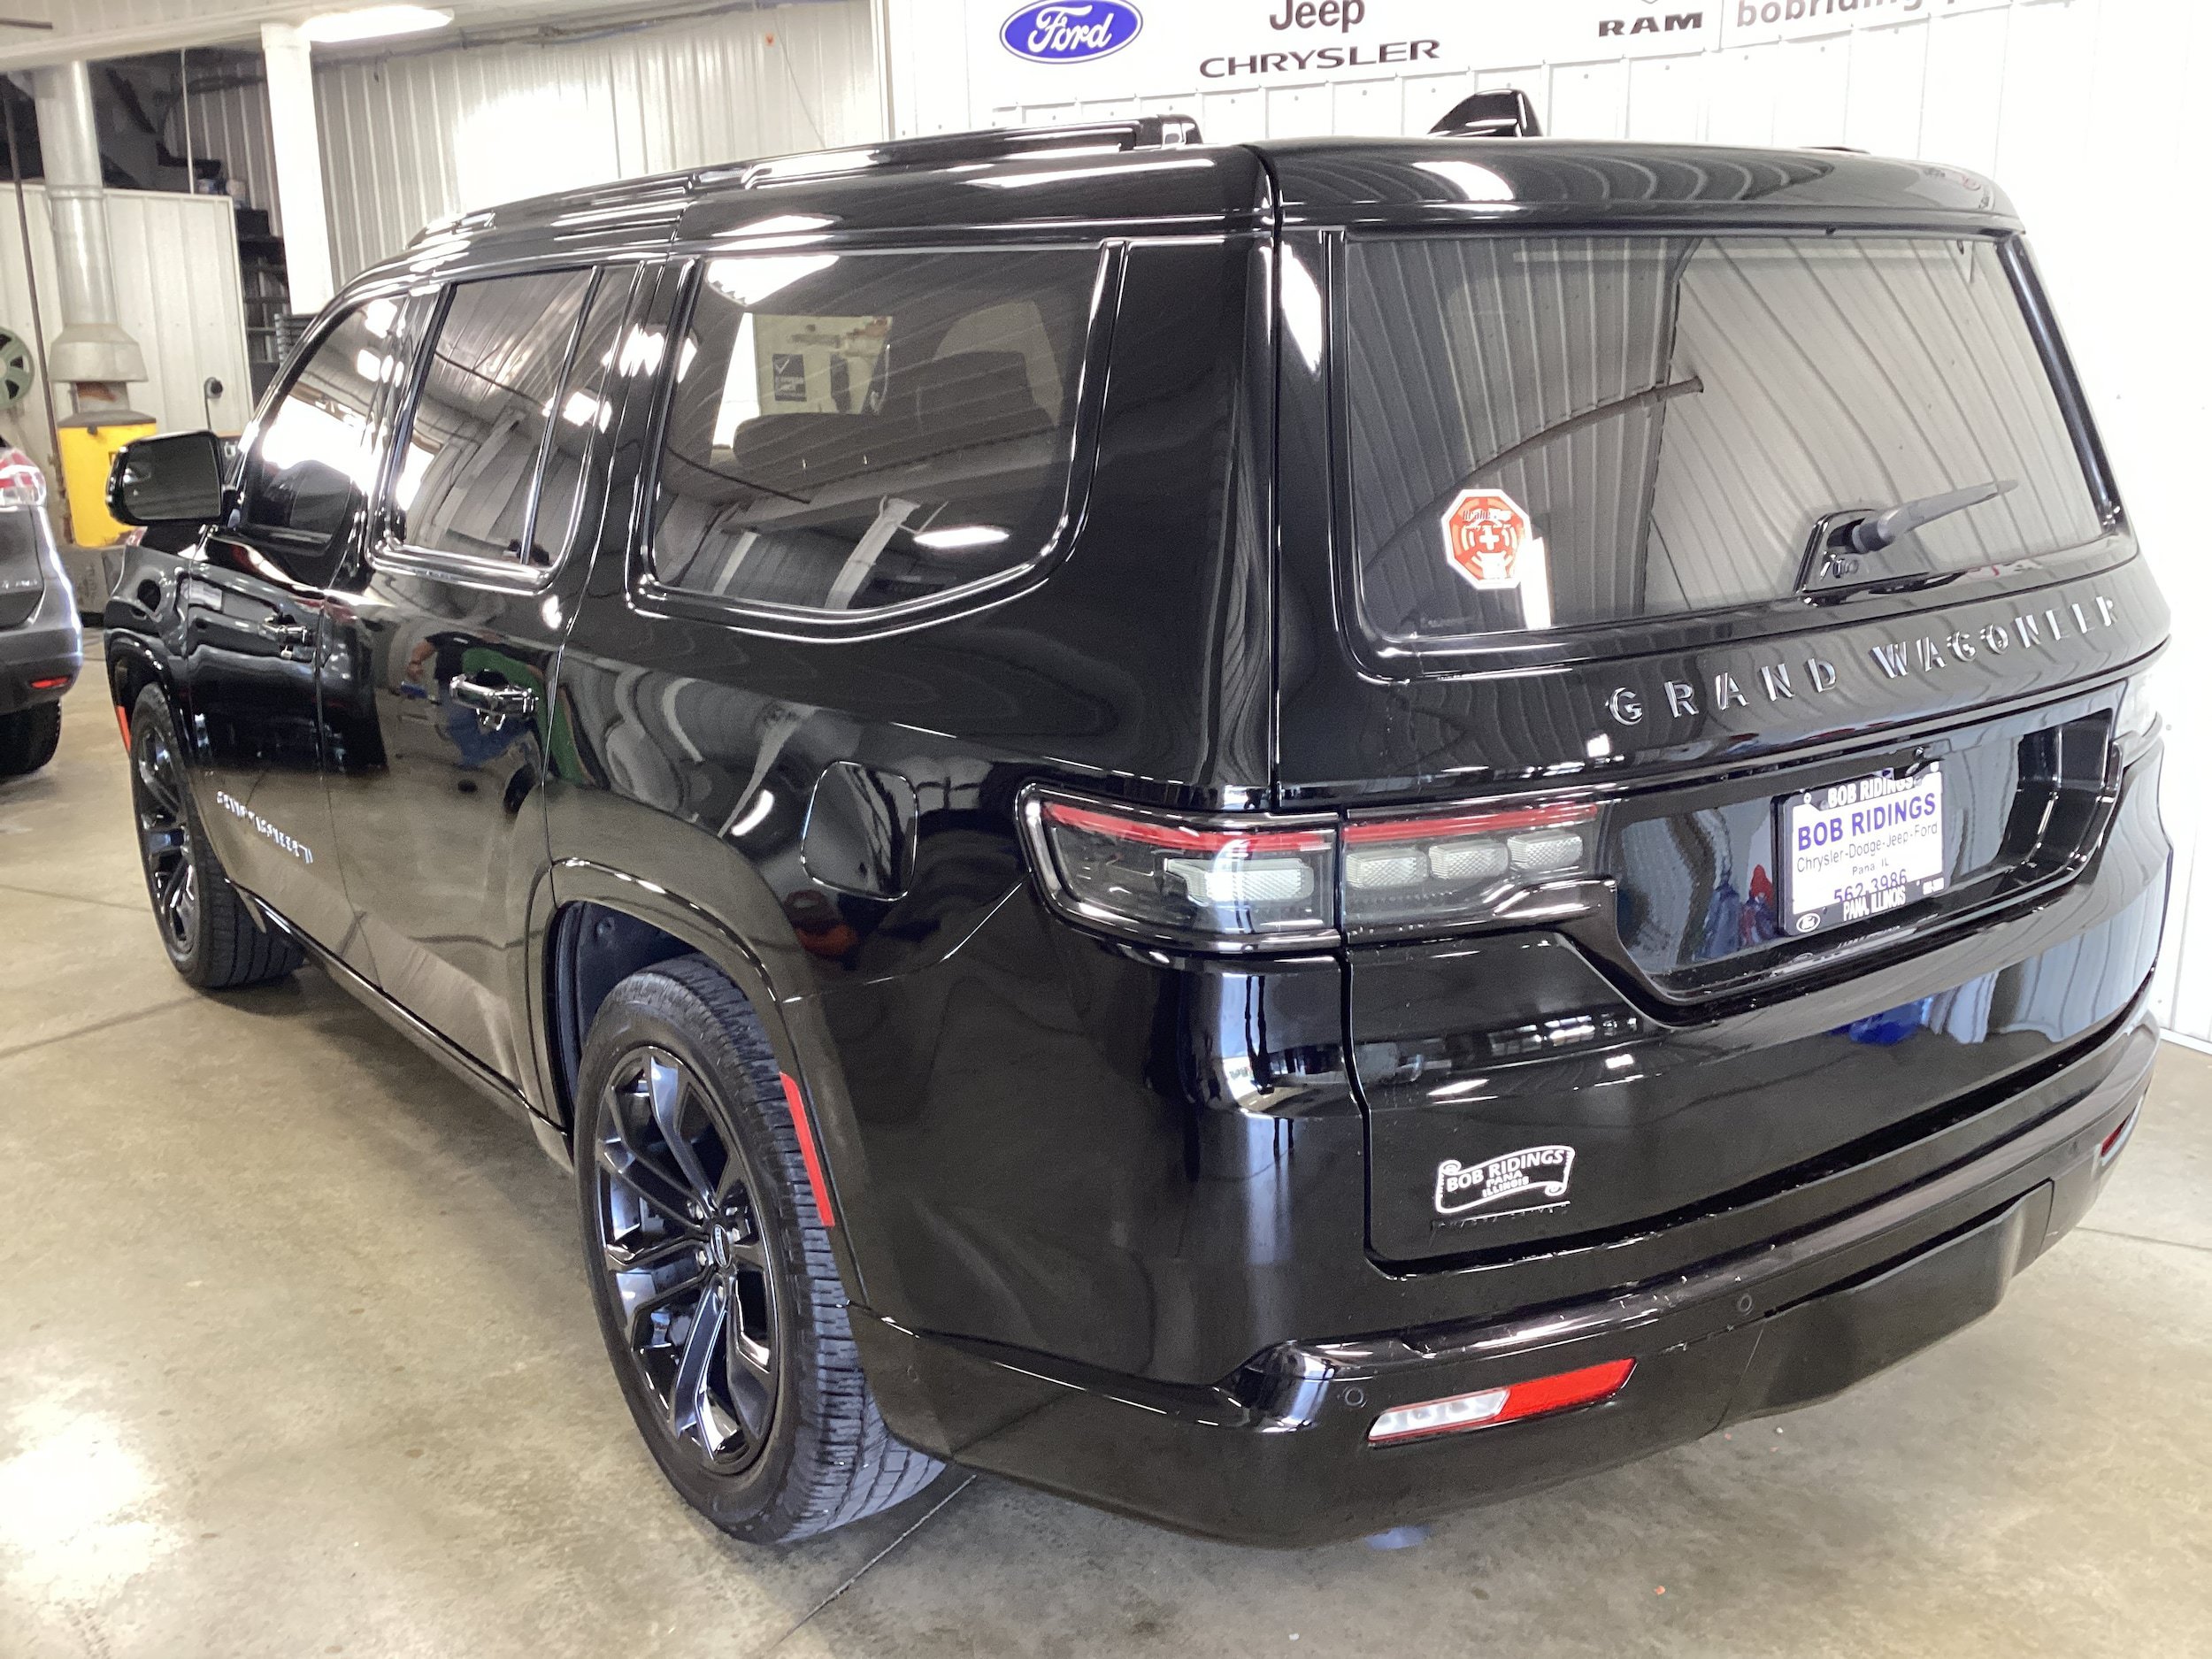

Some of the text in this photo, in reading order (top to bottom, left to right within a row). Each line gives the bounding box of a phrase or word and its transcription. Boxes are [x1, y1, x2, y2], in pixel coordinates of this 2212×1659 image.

[1028, 5, 1114, 53] Ford
[1270, 0, 1365, 34] Jeep
[1599, 12, 1703, 37] RAM
[1200, 39, 1440, 78] CHRYSLER
[1605, 657, 1837, 726] GRAND
[1828, 783, 1857, 808] BOB
[1798, 793, 1936, 851] BOB RIDINGS
[1852, 857, 1890, 876] Pana IL
[1870, 885, 1906, 913] ILLINOIS
[1446, 1150, 1565, 1192] BOB RIDINGS
[1486, 1170, 1524, 1187] PANA
[1482, 1176, 1530, 1198] ILLINOIS
